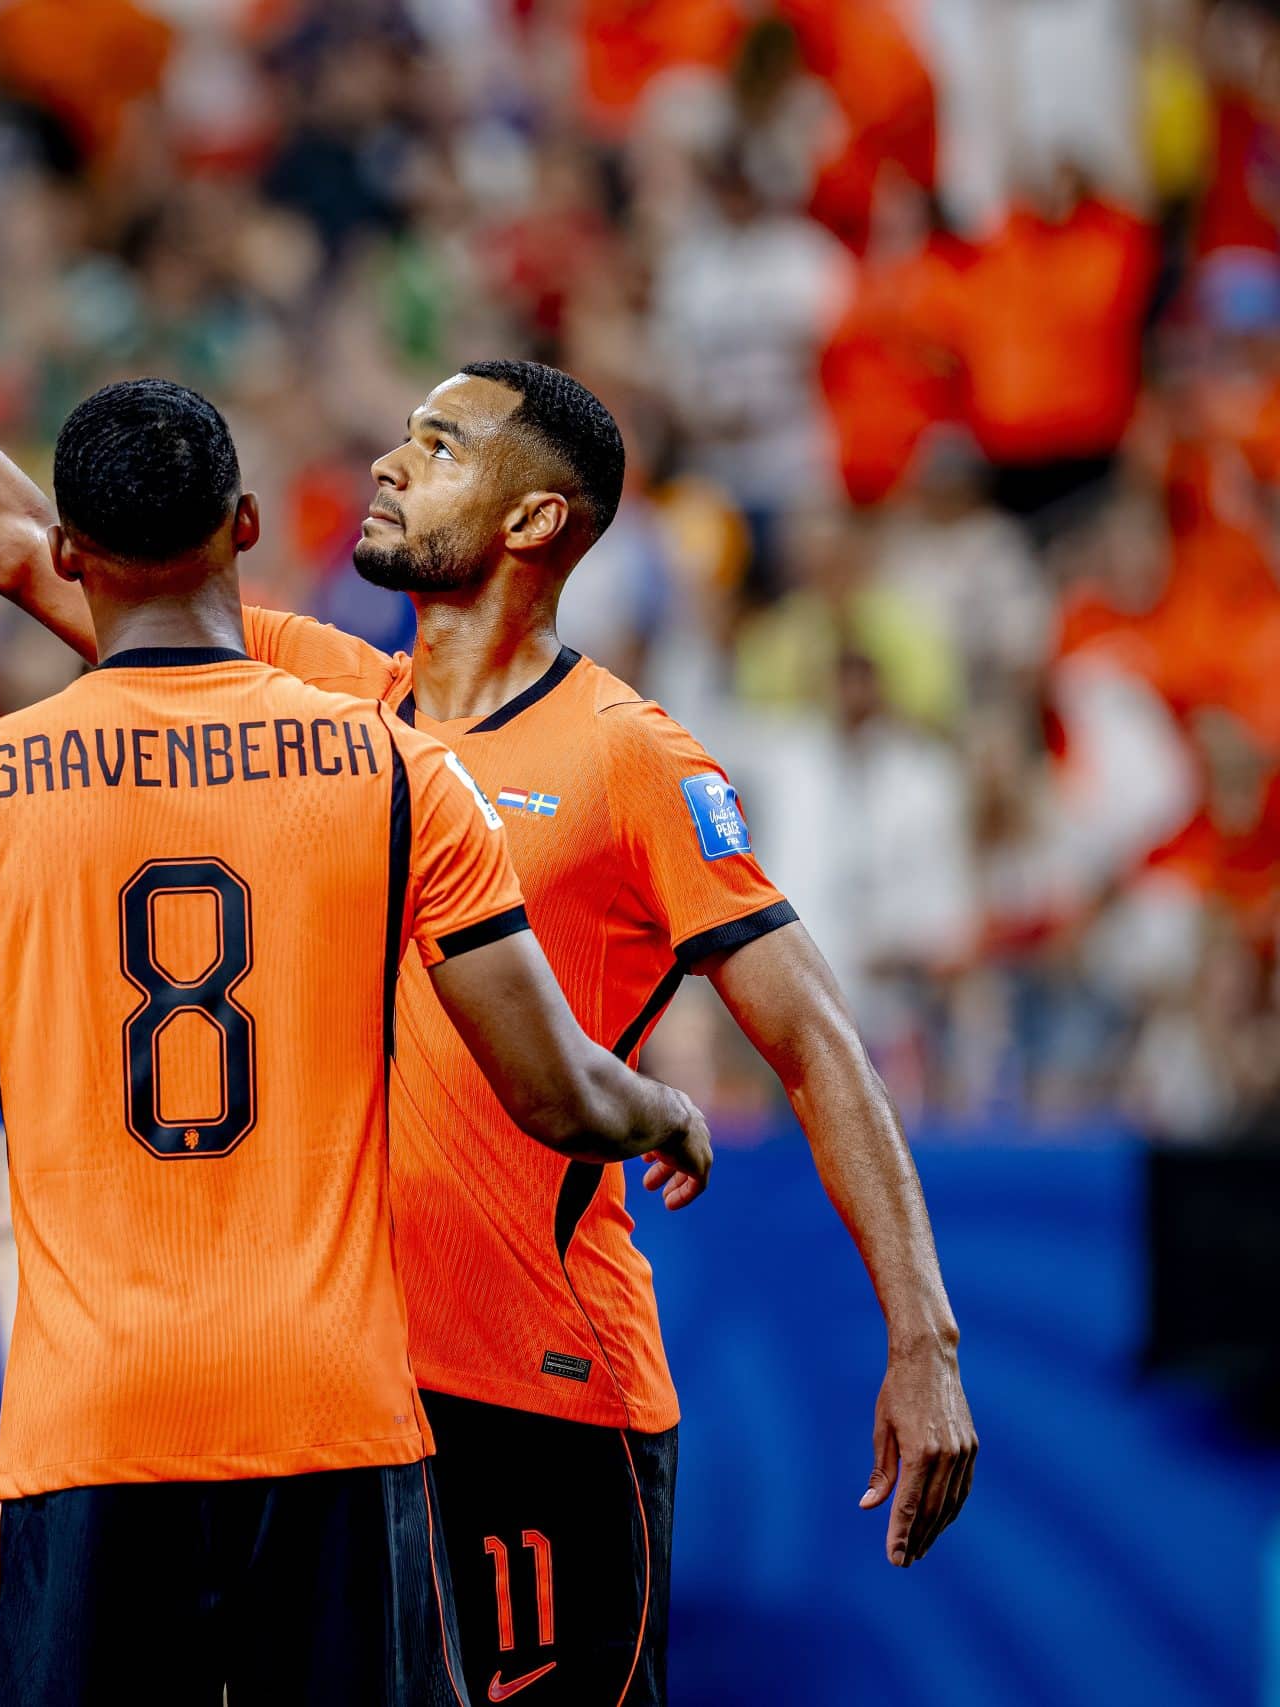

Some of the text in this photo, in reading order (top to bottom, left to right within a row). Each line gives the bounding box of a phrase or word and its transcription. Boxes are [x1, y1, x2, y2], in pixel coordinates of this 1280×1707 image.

[715, 821, 741, 838] PEACE
[118, 856, 257, 1160] 8
[483, 1529, 555, 1652] 11
